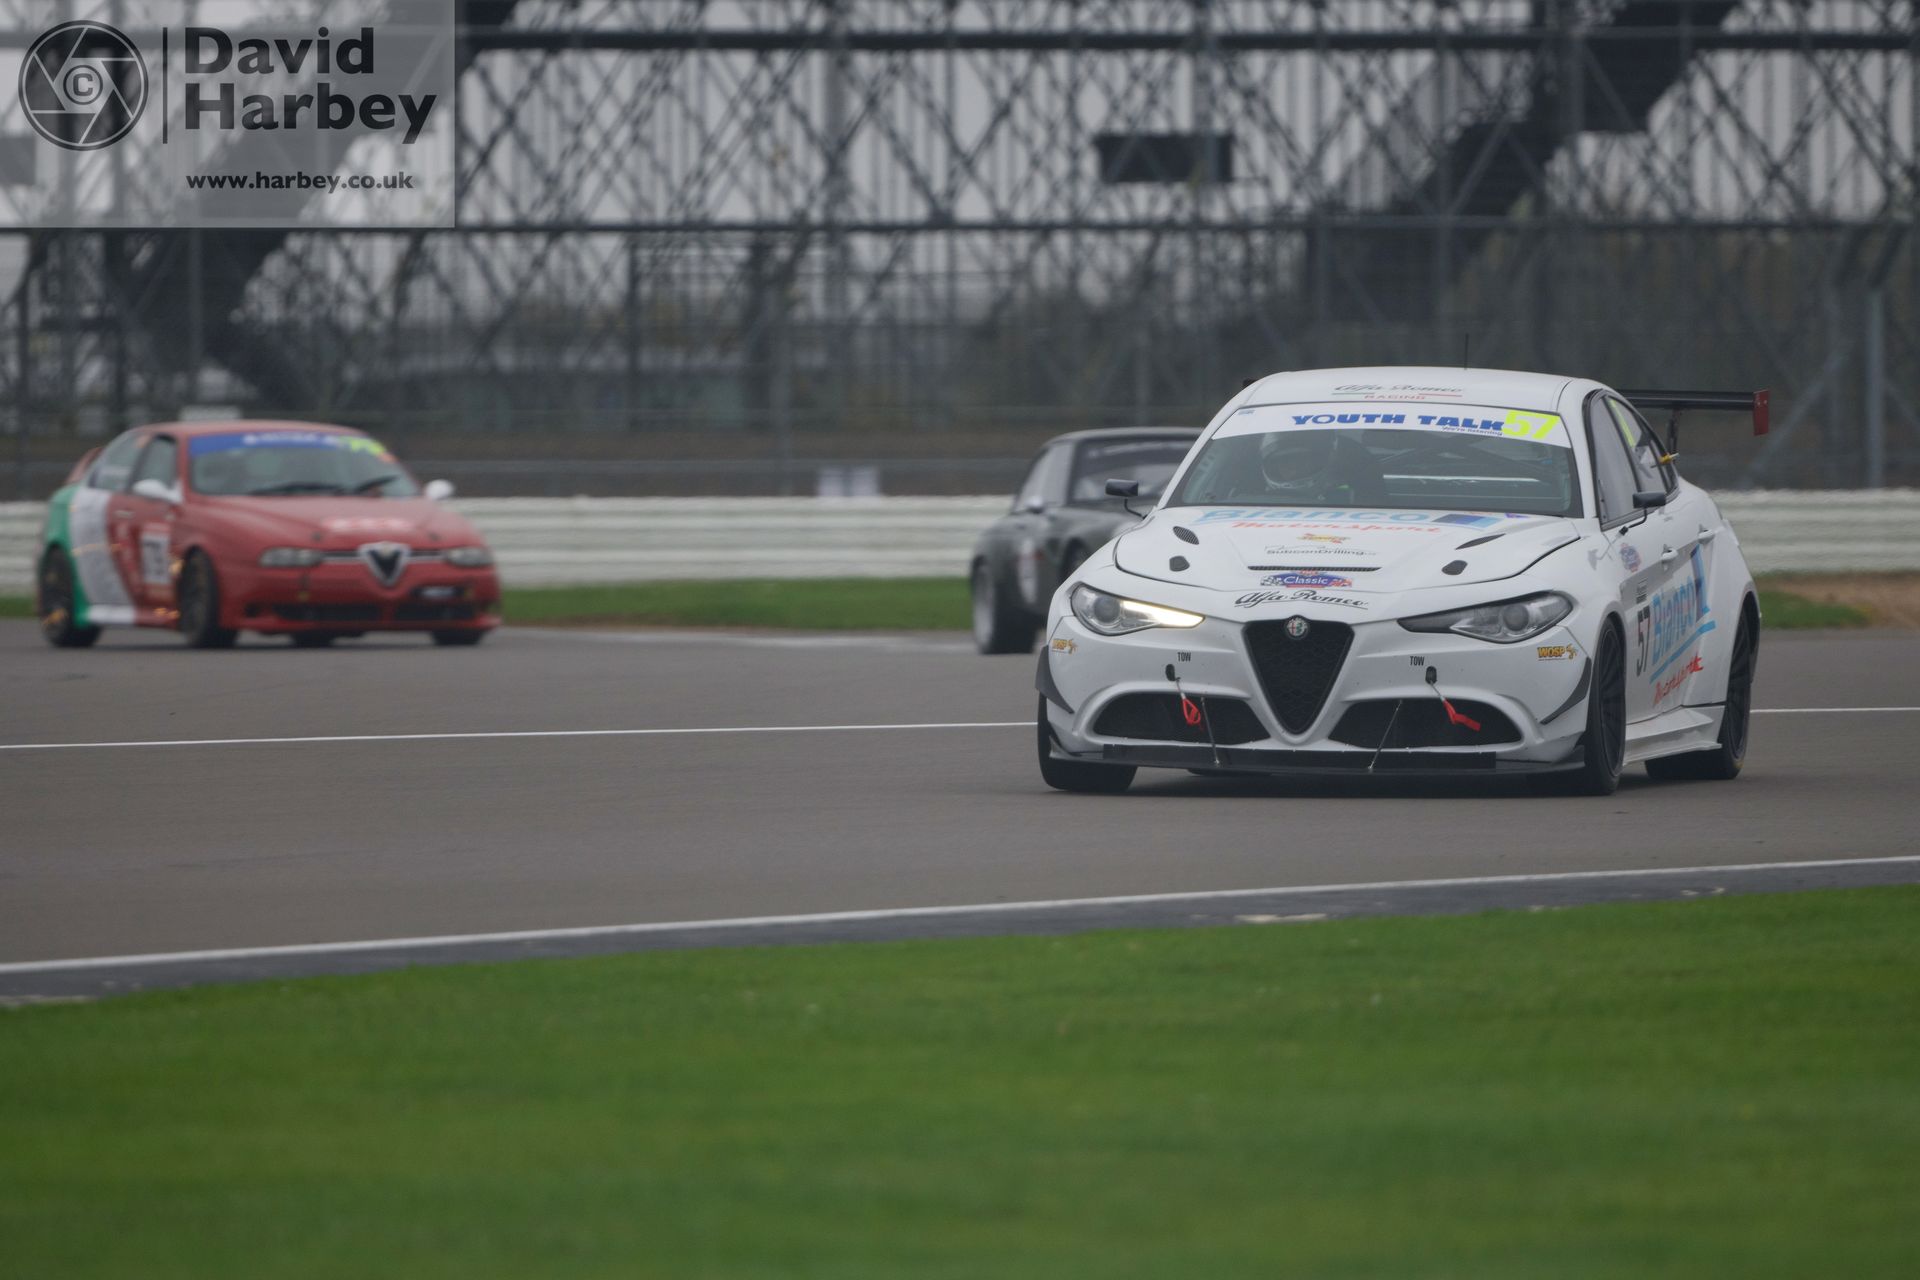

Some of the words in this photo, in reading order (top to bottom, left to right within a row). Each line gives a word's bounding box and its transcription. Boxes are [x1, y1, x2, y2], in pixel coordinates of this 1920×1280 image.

[1292, 414, 1406, 425] YOUTH
[1417, 415, 1504, 431] TALK
[1502, 409, 1560, 439] 57
[1193, 508, 1430, 522] Bianco
[1283, 576, 1329, 585] Classic
[1234, 590, 1283, 608] Alfa
[1290, 589, 1364, 606] Romeo
[1651, 576, 1697, 666] Bianco
[1636, 605, 1651, 678] 57
[1177, 652, 1192, 662] TOW
[1537, 645, 1566, 658] WOSP
[1409, 655, 1425, 666] TOW
